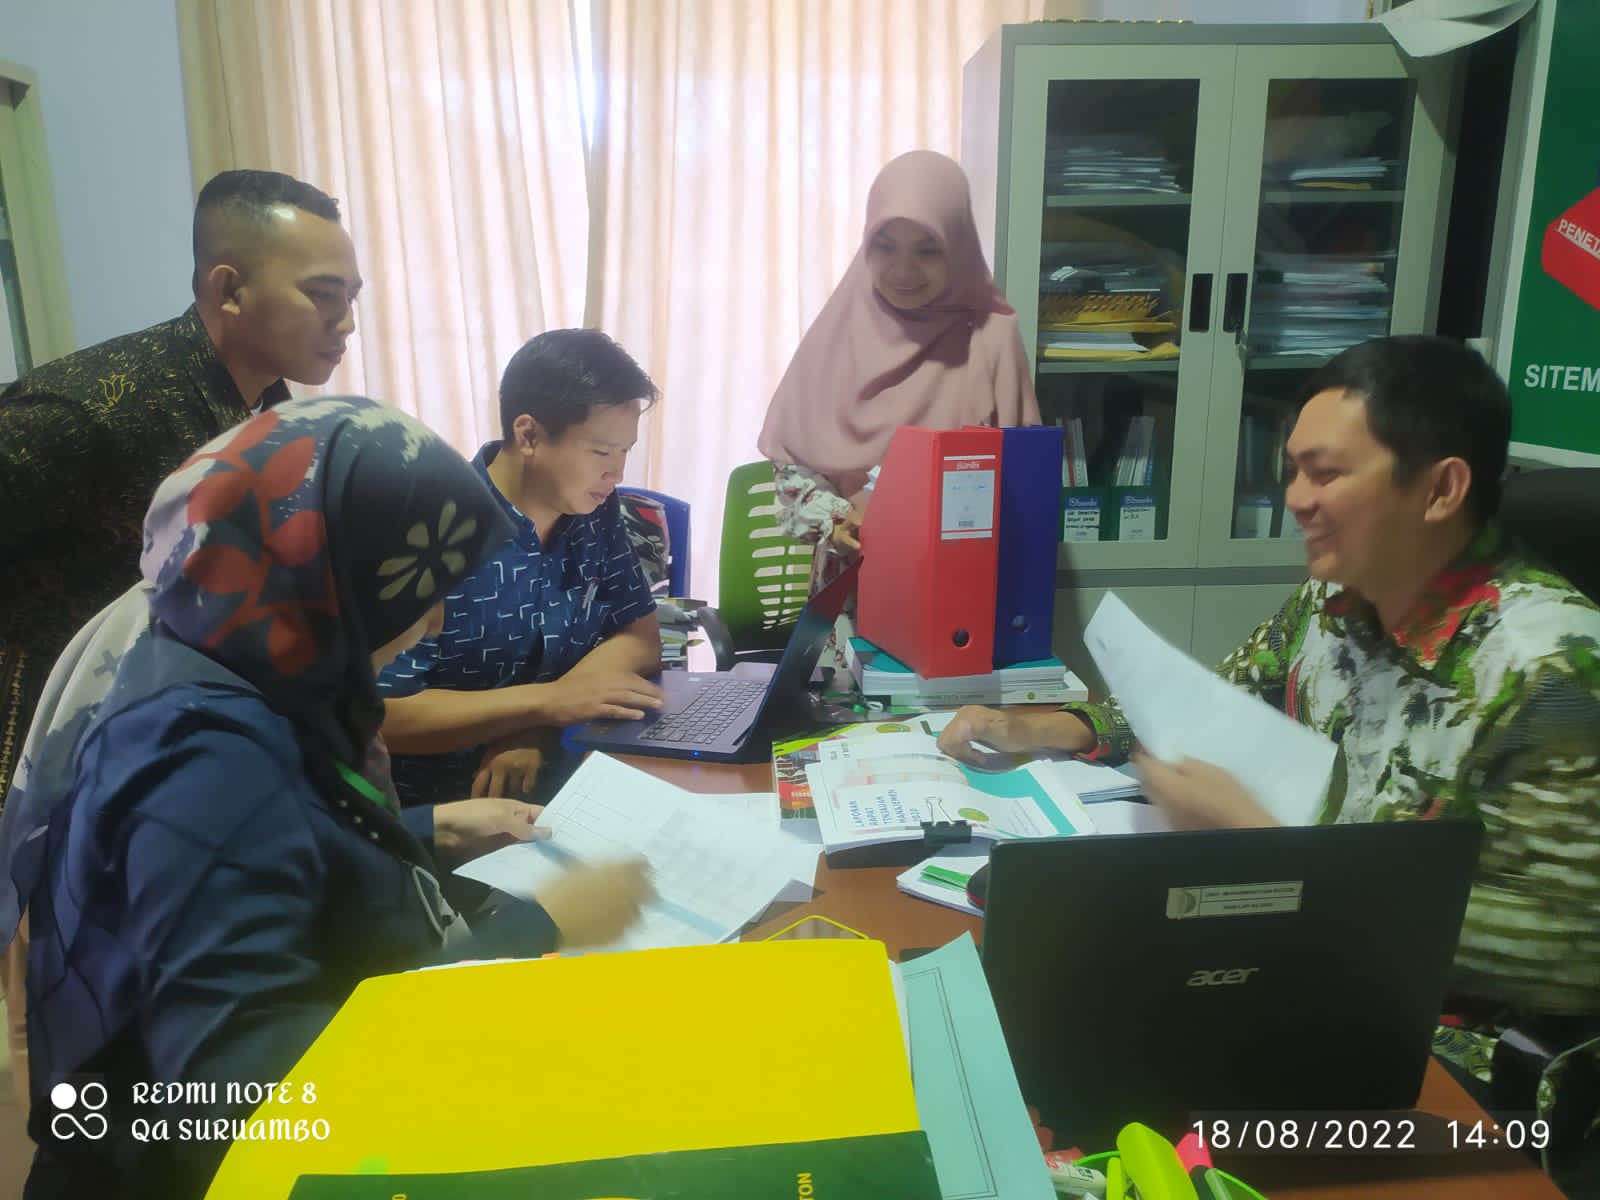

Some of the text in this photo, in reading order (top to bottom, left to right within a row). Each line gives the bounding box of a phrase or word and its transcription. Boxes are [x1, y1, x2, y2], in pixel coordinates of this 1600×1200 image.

[1557, 218, 1600, 254] PENET
[1524, 364, 1600, 392] SITEM
[1186, 967, 1260, 987] acer
